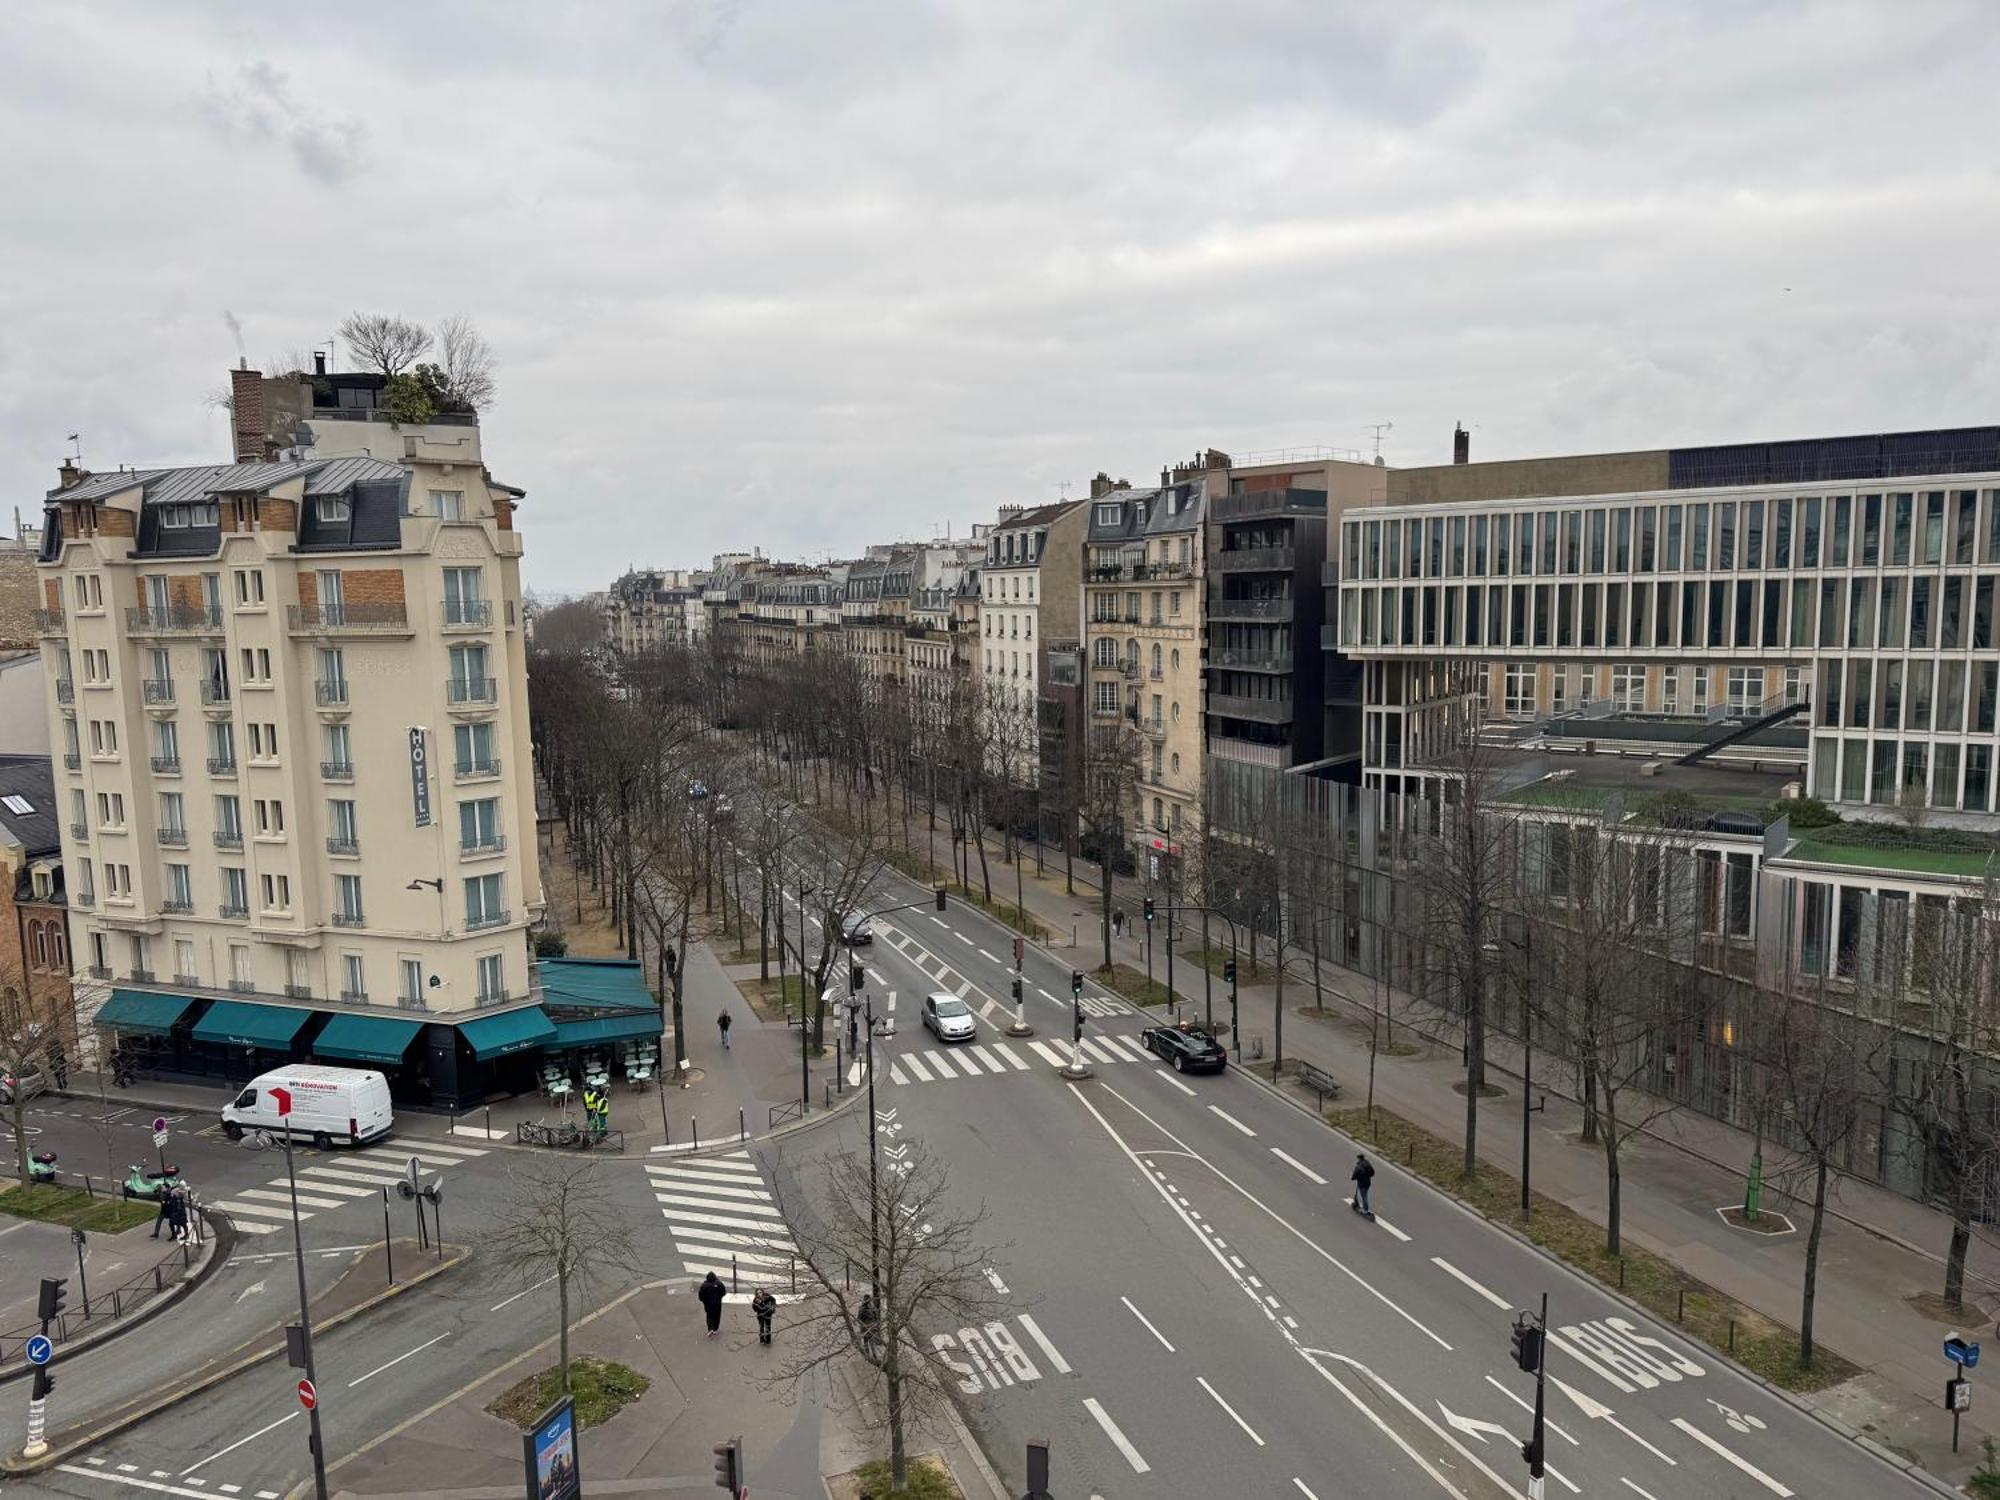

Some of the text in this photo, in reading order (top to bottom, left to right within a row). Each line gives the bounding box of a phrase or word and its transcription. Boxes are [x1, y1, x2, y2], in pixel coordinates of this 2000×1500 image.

[1070, 997, 1133, 1018] BUS
[929, 1320, 1043, 1394] BUS
[1557, 1317, 1707, 1389] BUS
